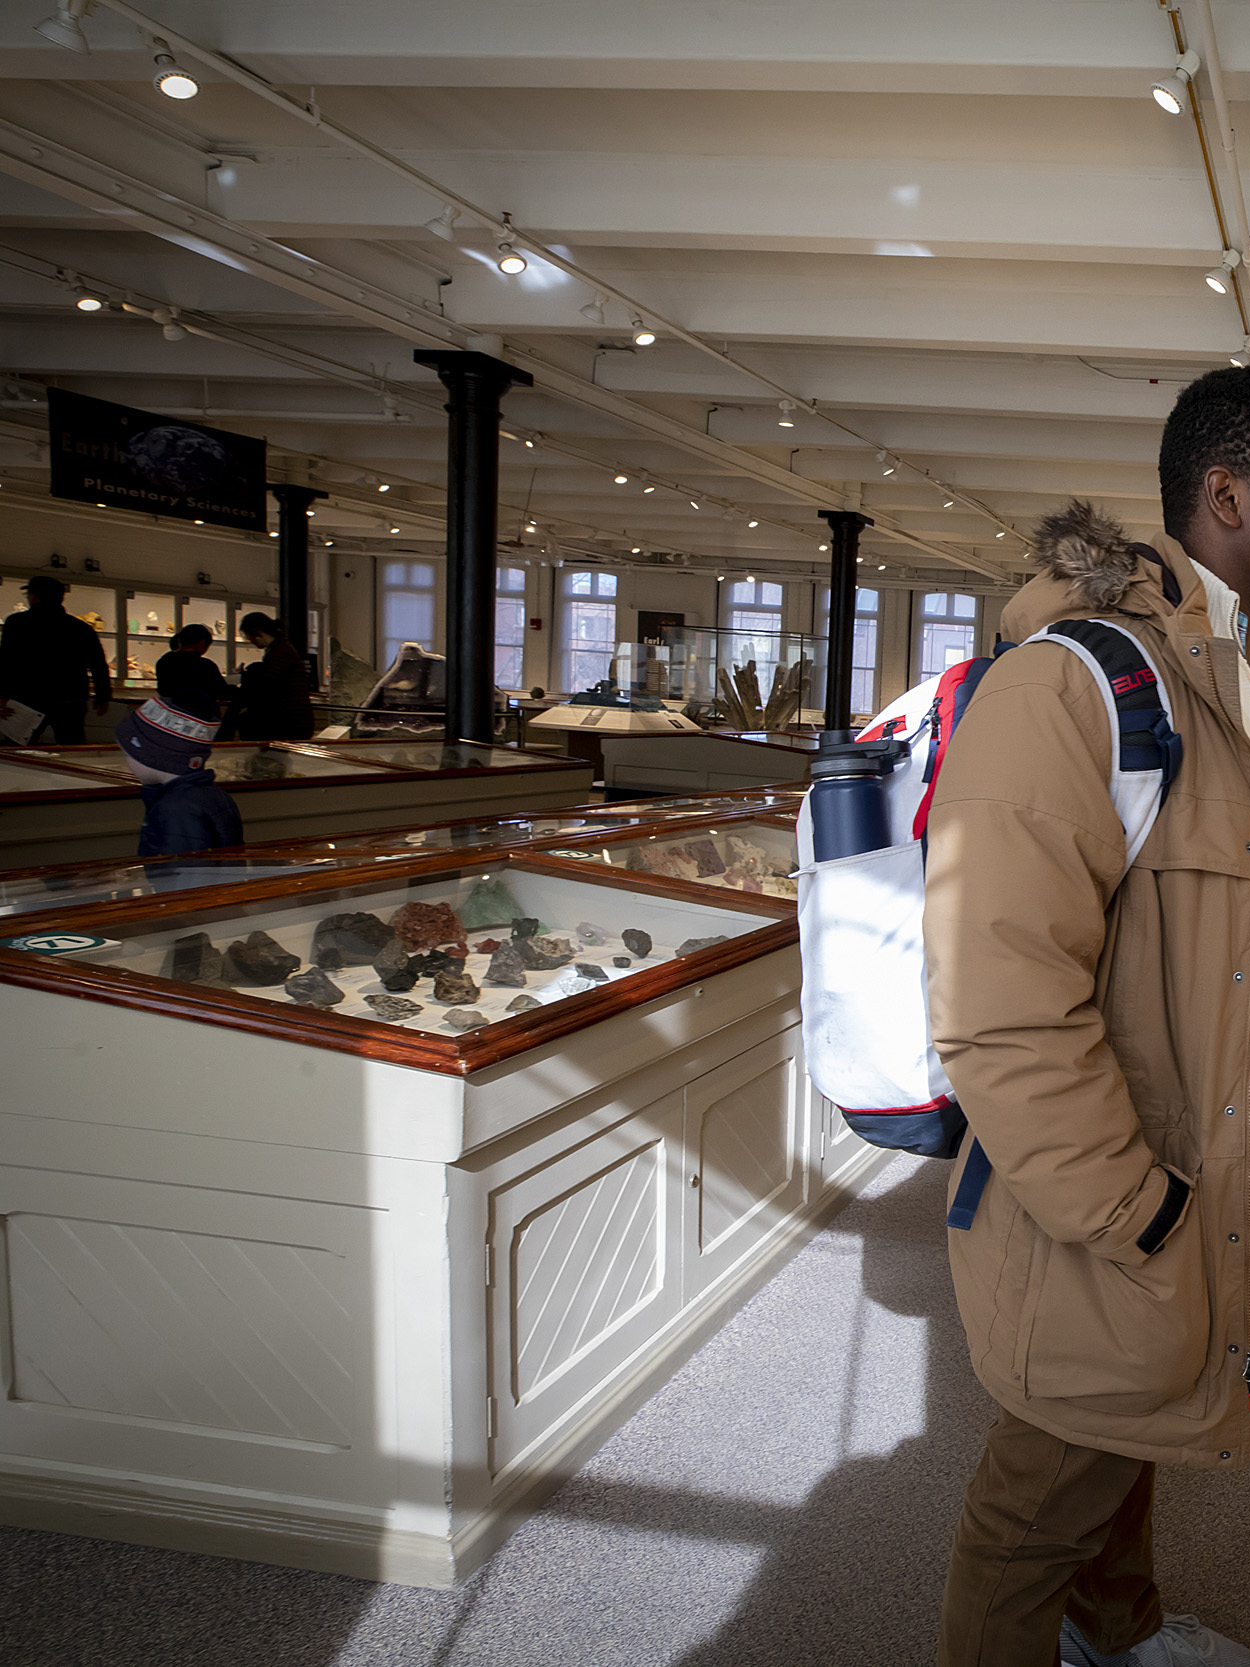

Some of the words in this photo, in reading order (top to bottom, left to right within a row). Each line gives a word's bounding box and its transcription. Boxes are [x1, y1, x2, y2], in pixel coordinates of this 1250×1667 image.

[61, 431, 126, 465] Earth
[83, 477, 180, 507] Planetary
[186, 496, 257, 519] Sciences
[1111, 668, 1157, 695] ELITE
[30, 937, 85, 949] 71
